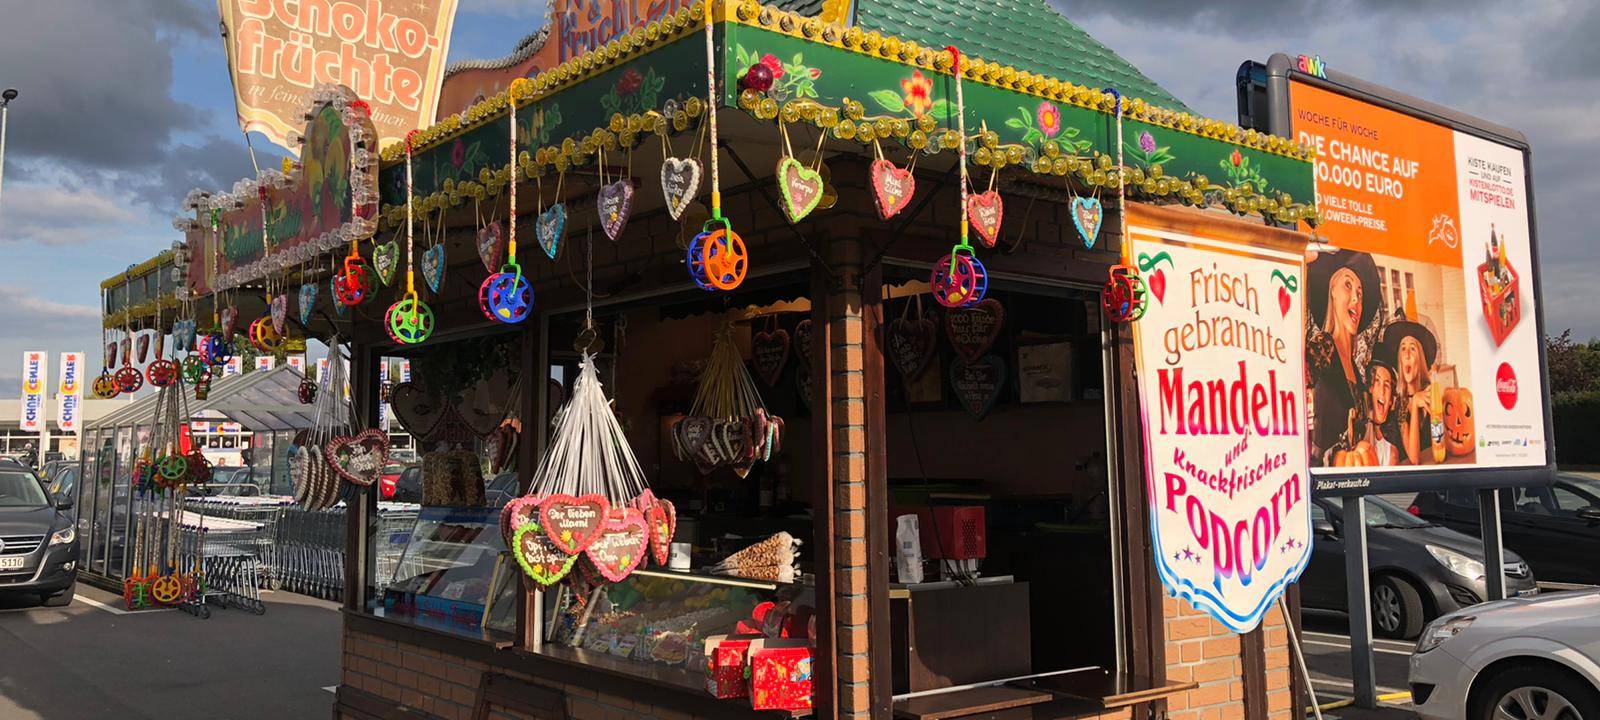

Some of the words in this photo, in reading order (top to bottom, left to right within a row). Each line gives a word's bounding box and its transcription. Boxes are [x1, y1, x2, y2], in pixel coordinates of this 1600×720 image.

[238, 18, 422, 110] früchte
[1298, 55, 1327, 80] awk
[1298, 109, 1330, 127] WOCHE
[1332, 117, 1348, 131] FÜR
[1350, 124, 1379, 140] WOCHE
[1330, 140, 1390, 173] CHANCE
[1393, 157, 1419, 179] AUF
[1467, 157, 1486, 170] KISTE
[1487, 162, 1512, 176] KAUFEN
[1365, 172, 1403, 199] EURO
[1470, 189, 1515, 209] MITSPIELEN
[1323, 195, 1346, 210] VIELE
[1348, 199, 1373, 215] TOLLE
[1325, 209, 1388, 232] OWEEN-PREISE.
[1190, 262, 1260, 315] Frisch
[1164, 310, 1287, 366] gebrannte
[1157, 360, 1299, 436] Mandeln
[1225, 429, 1248, 467] und
[1173, 447, 1287, 500] Knackfrisches
[1316, 478, 1370, 490] Plakat-verkauft.de
[548, 509, 565, 520] Der
[567, 508, 596, 519] lieben
[559, 519, 589, 528] Mami
[1164, 472, 1302, 598] Popcorn
